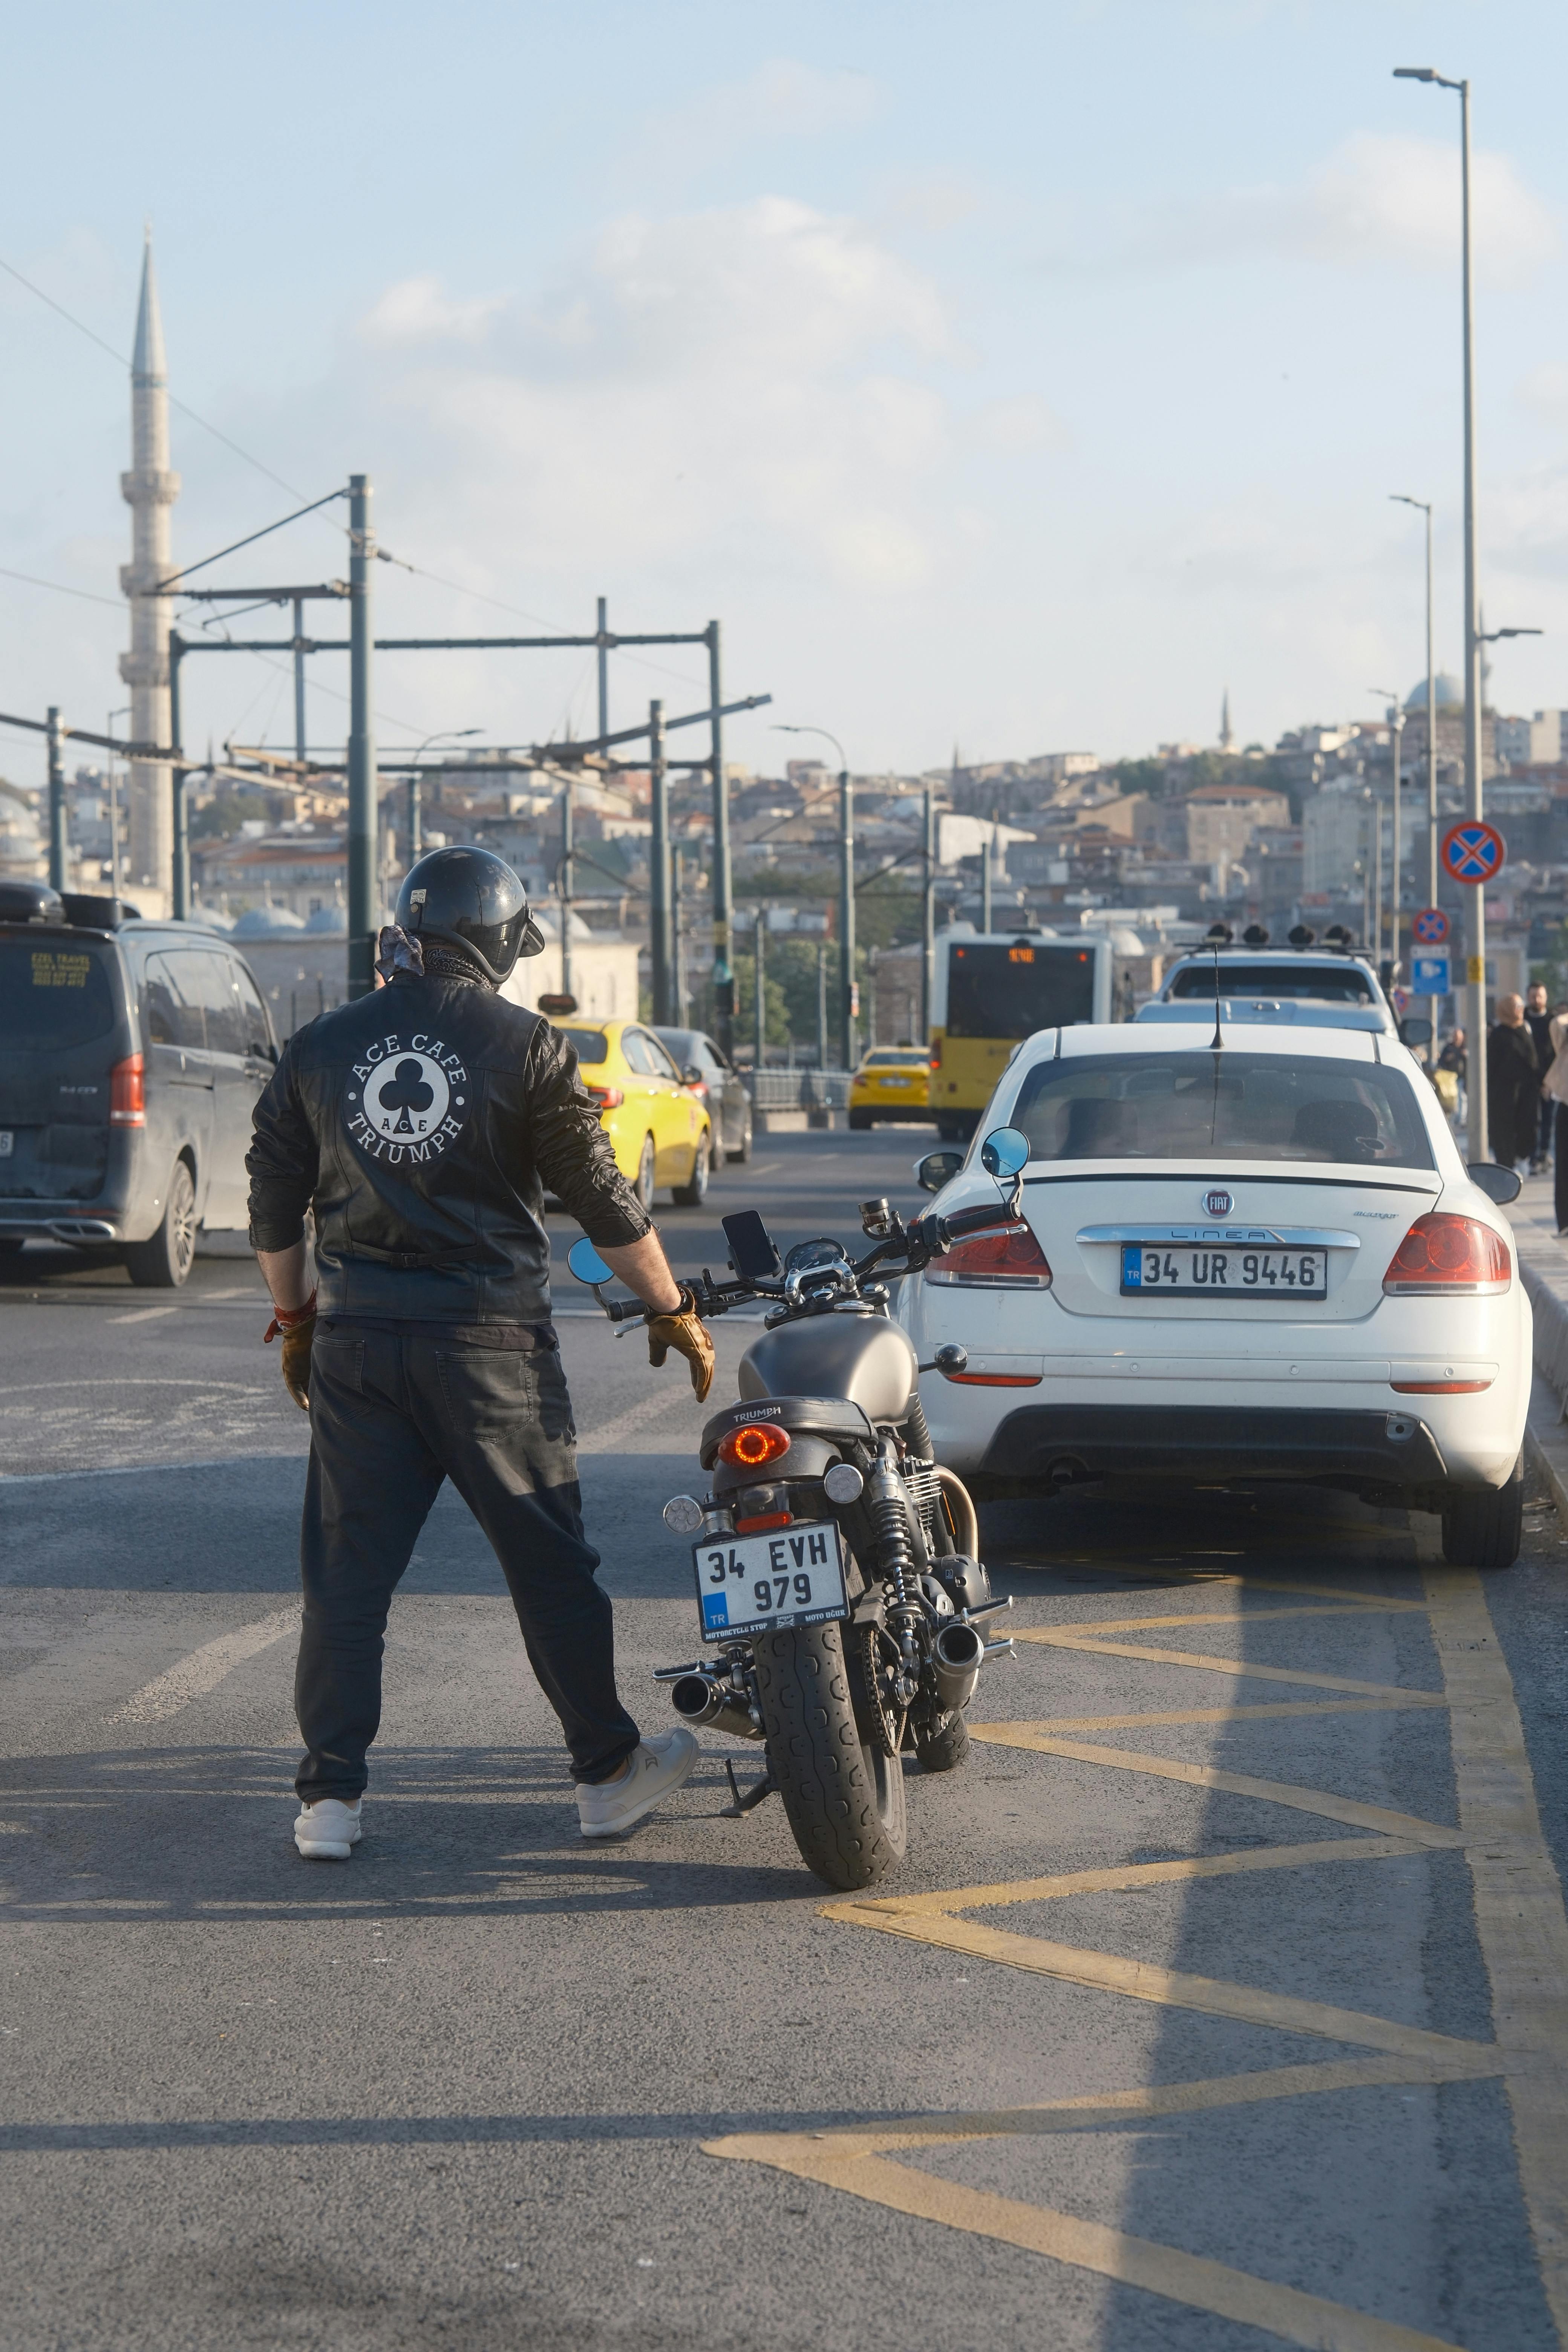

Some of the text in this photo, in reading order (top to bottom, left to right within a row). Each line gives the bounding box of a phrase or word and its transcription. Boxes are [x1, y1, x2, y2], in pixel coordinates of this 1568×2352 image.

[352, 1034, 467, 1084] ACE CAFE
[381, 1118, 427, 1132] ACE
[348, 1112, 463, 1164] TRIUMPH
[1210, 1197, 1228, 1210] FIAT
[1171, 1231, 1265, 1240] LINEA
[1127, 1271, 1139, 1279] TR
[1144, 1253, 1316, 1286] 34 UR 9446
[733, 1406, 781, 1422] TRIUMPH
[708, 1533, 827, 1583] 34 EVH
[754, 1573, 812, 1612] 979
[710, 1614, 725, 1625] TR
[805, 1609, 845, 1622] MOTO UĞUR
[705, 1623, 767, 1640] MOTORCYCLE STOP
